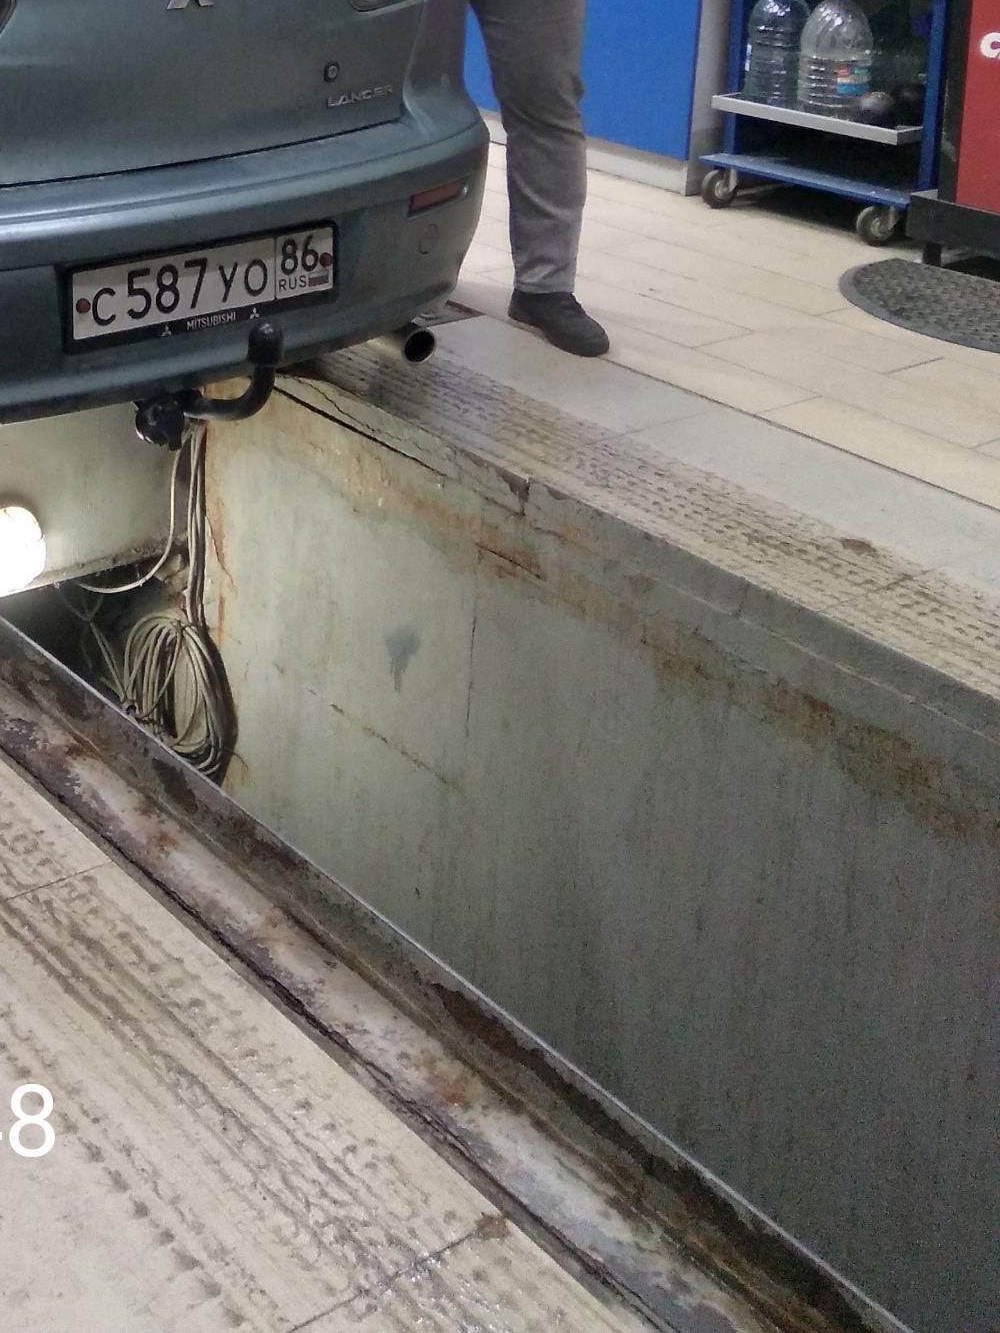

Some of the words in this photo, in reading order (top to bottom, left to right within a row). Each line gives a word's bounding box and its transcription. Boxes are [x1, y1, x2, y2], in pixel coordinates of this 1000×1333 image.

[280, 235, 319, 276] 86
[278, 274, 307, 291] RUS
[186, 311, 236, 331] MITSUBISHI
